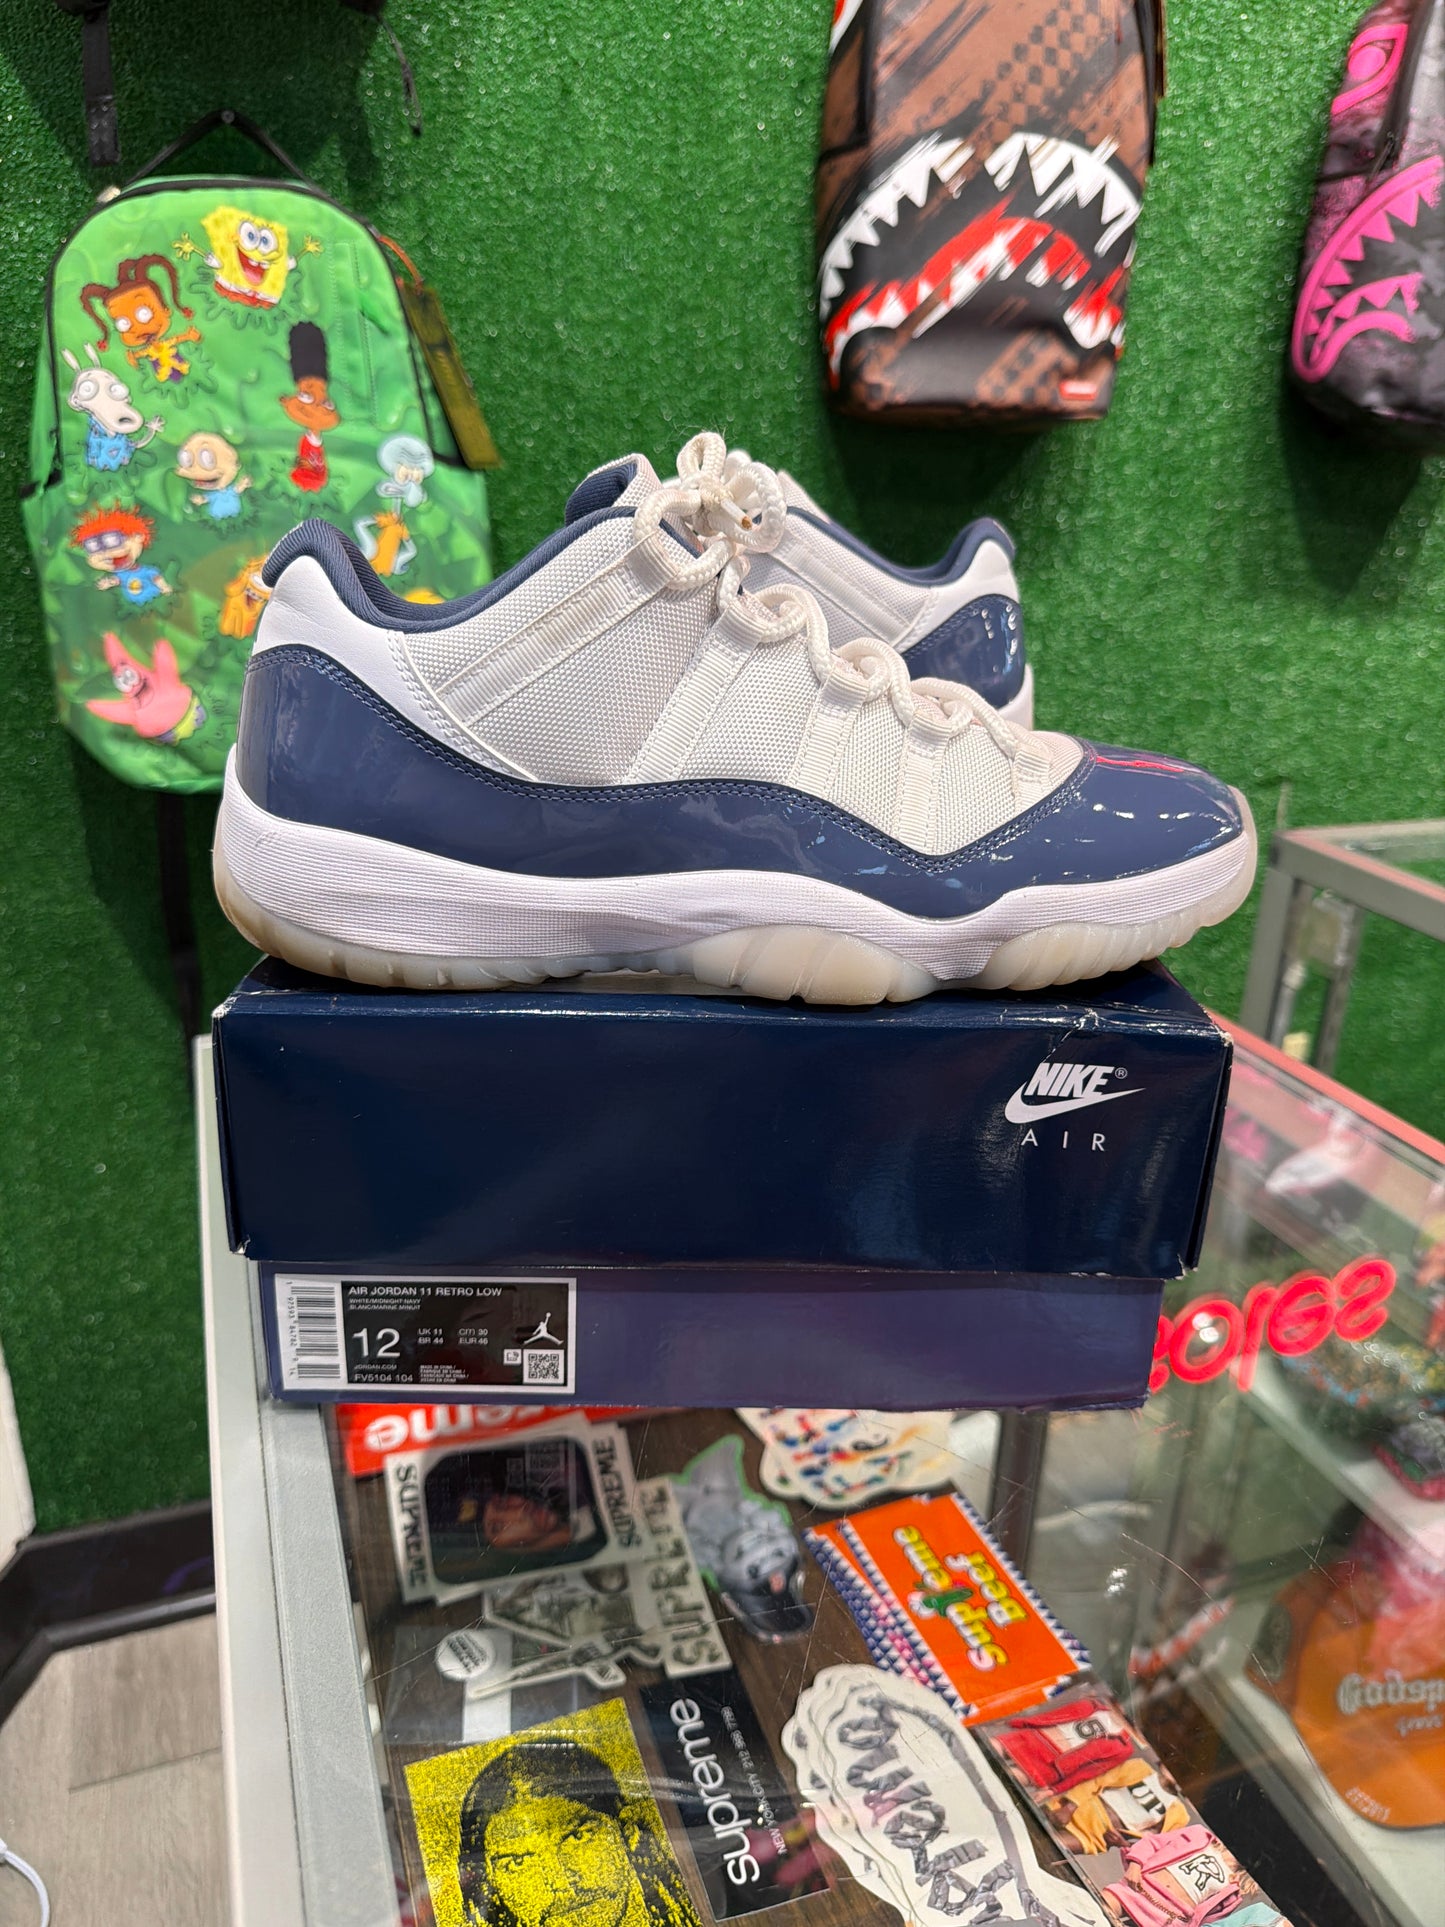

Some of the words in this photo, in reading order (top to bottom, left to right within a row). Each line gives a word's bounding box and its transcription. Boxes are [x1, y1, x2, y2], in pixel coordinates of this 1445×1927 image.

[1024, 1062, 1115, 1098] NIKE
[1021, 1128, 1106, 1151] AIR
[349, 1287, 368, 1296] AIR
[370, 1287, 417, 1296] JORDAN
[419, 1287, 432, 1296] 11
[435, 1287, 474, 1297] RETRO
[476, 1287, 502, 1297] LOW
[352, 1328, 401, 1358] 12
[354, 1374, 392, 1382] FV5104
[395, 1374, 413, 1383] 104
[944, 1552, 1027, 1627] Beef
[669, 1698, 760, 1885] supreme
[747, 1773, 765, 1798] CITY
[1127, 1780, 1167, 1816] UP
[758, 1796, 778, 1829] YORK
[768, 1828, 787, 1855] NEW
